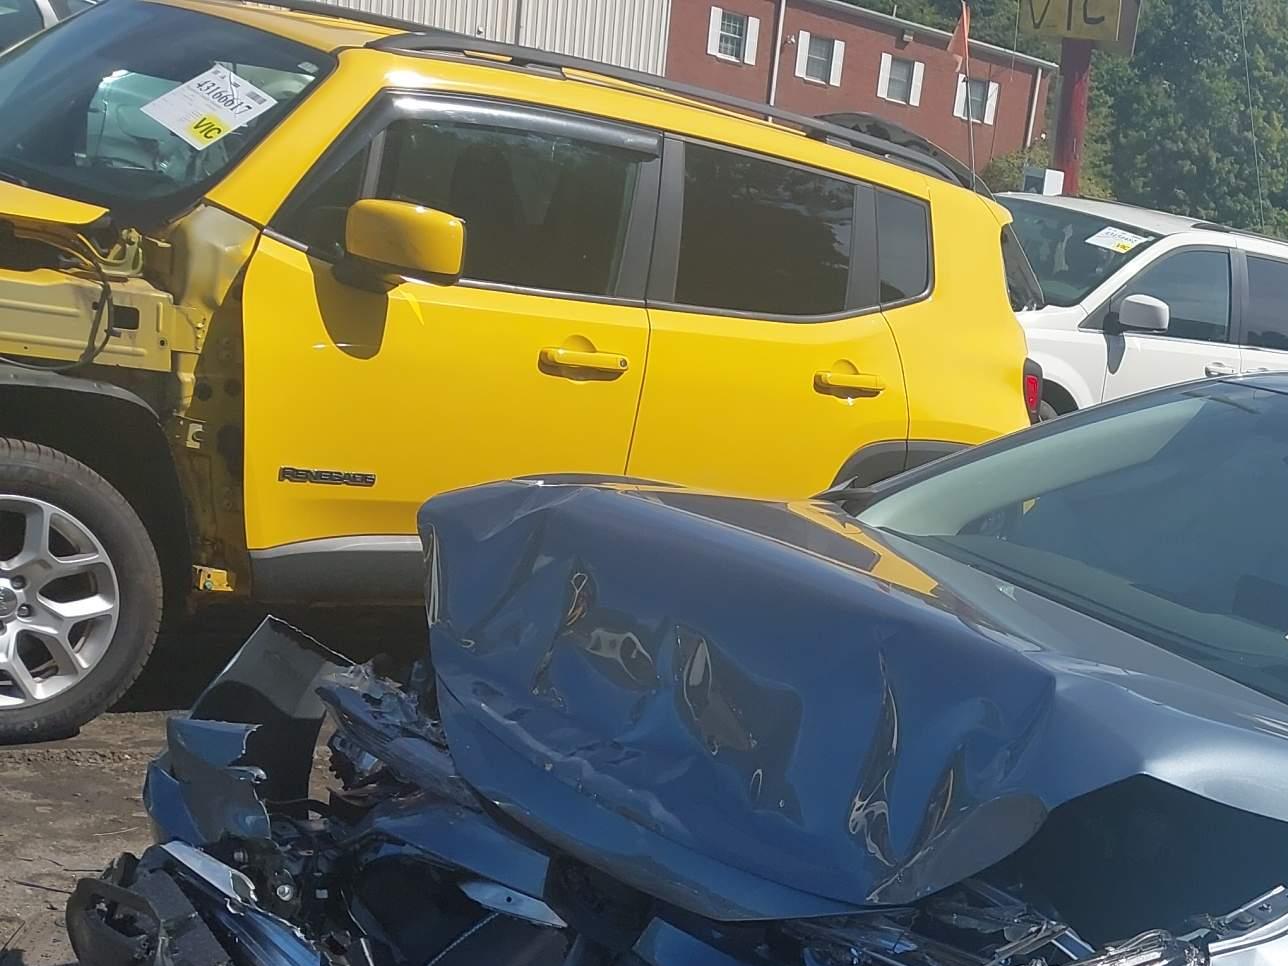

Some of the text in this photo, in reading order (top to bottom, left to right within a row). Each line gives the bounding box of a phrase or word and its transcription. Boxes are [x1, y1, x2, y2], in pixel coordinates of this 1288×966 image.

[1029, 0, 1105, 31] VIC
[193, 117, 222, 140] VIC
[278, 467, 376, 487] RENEGADE
